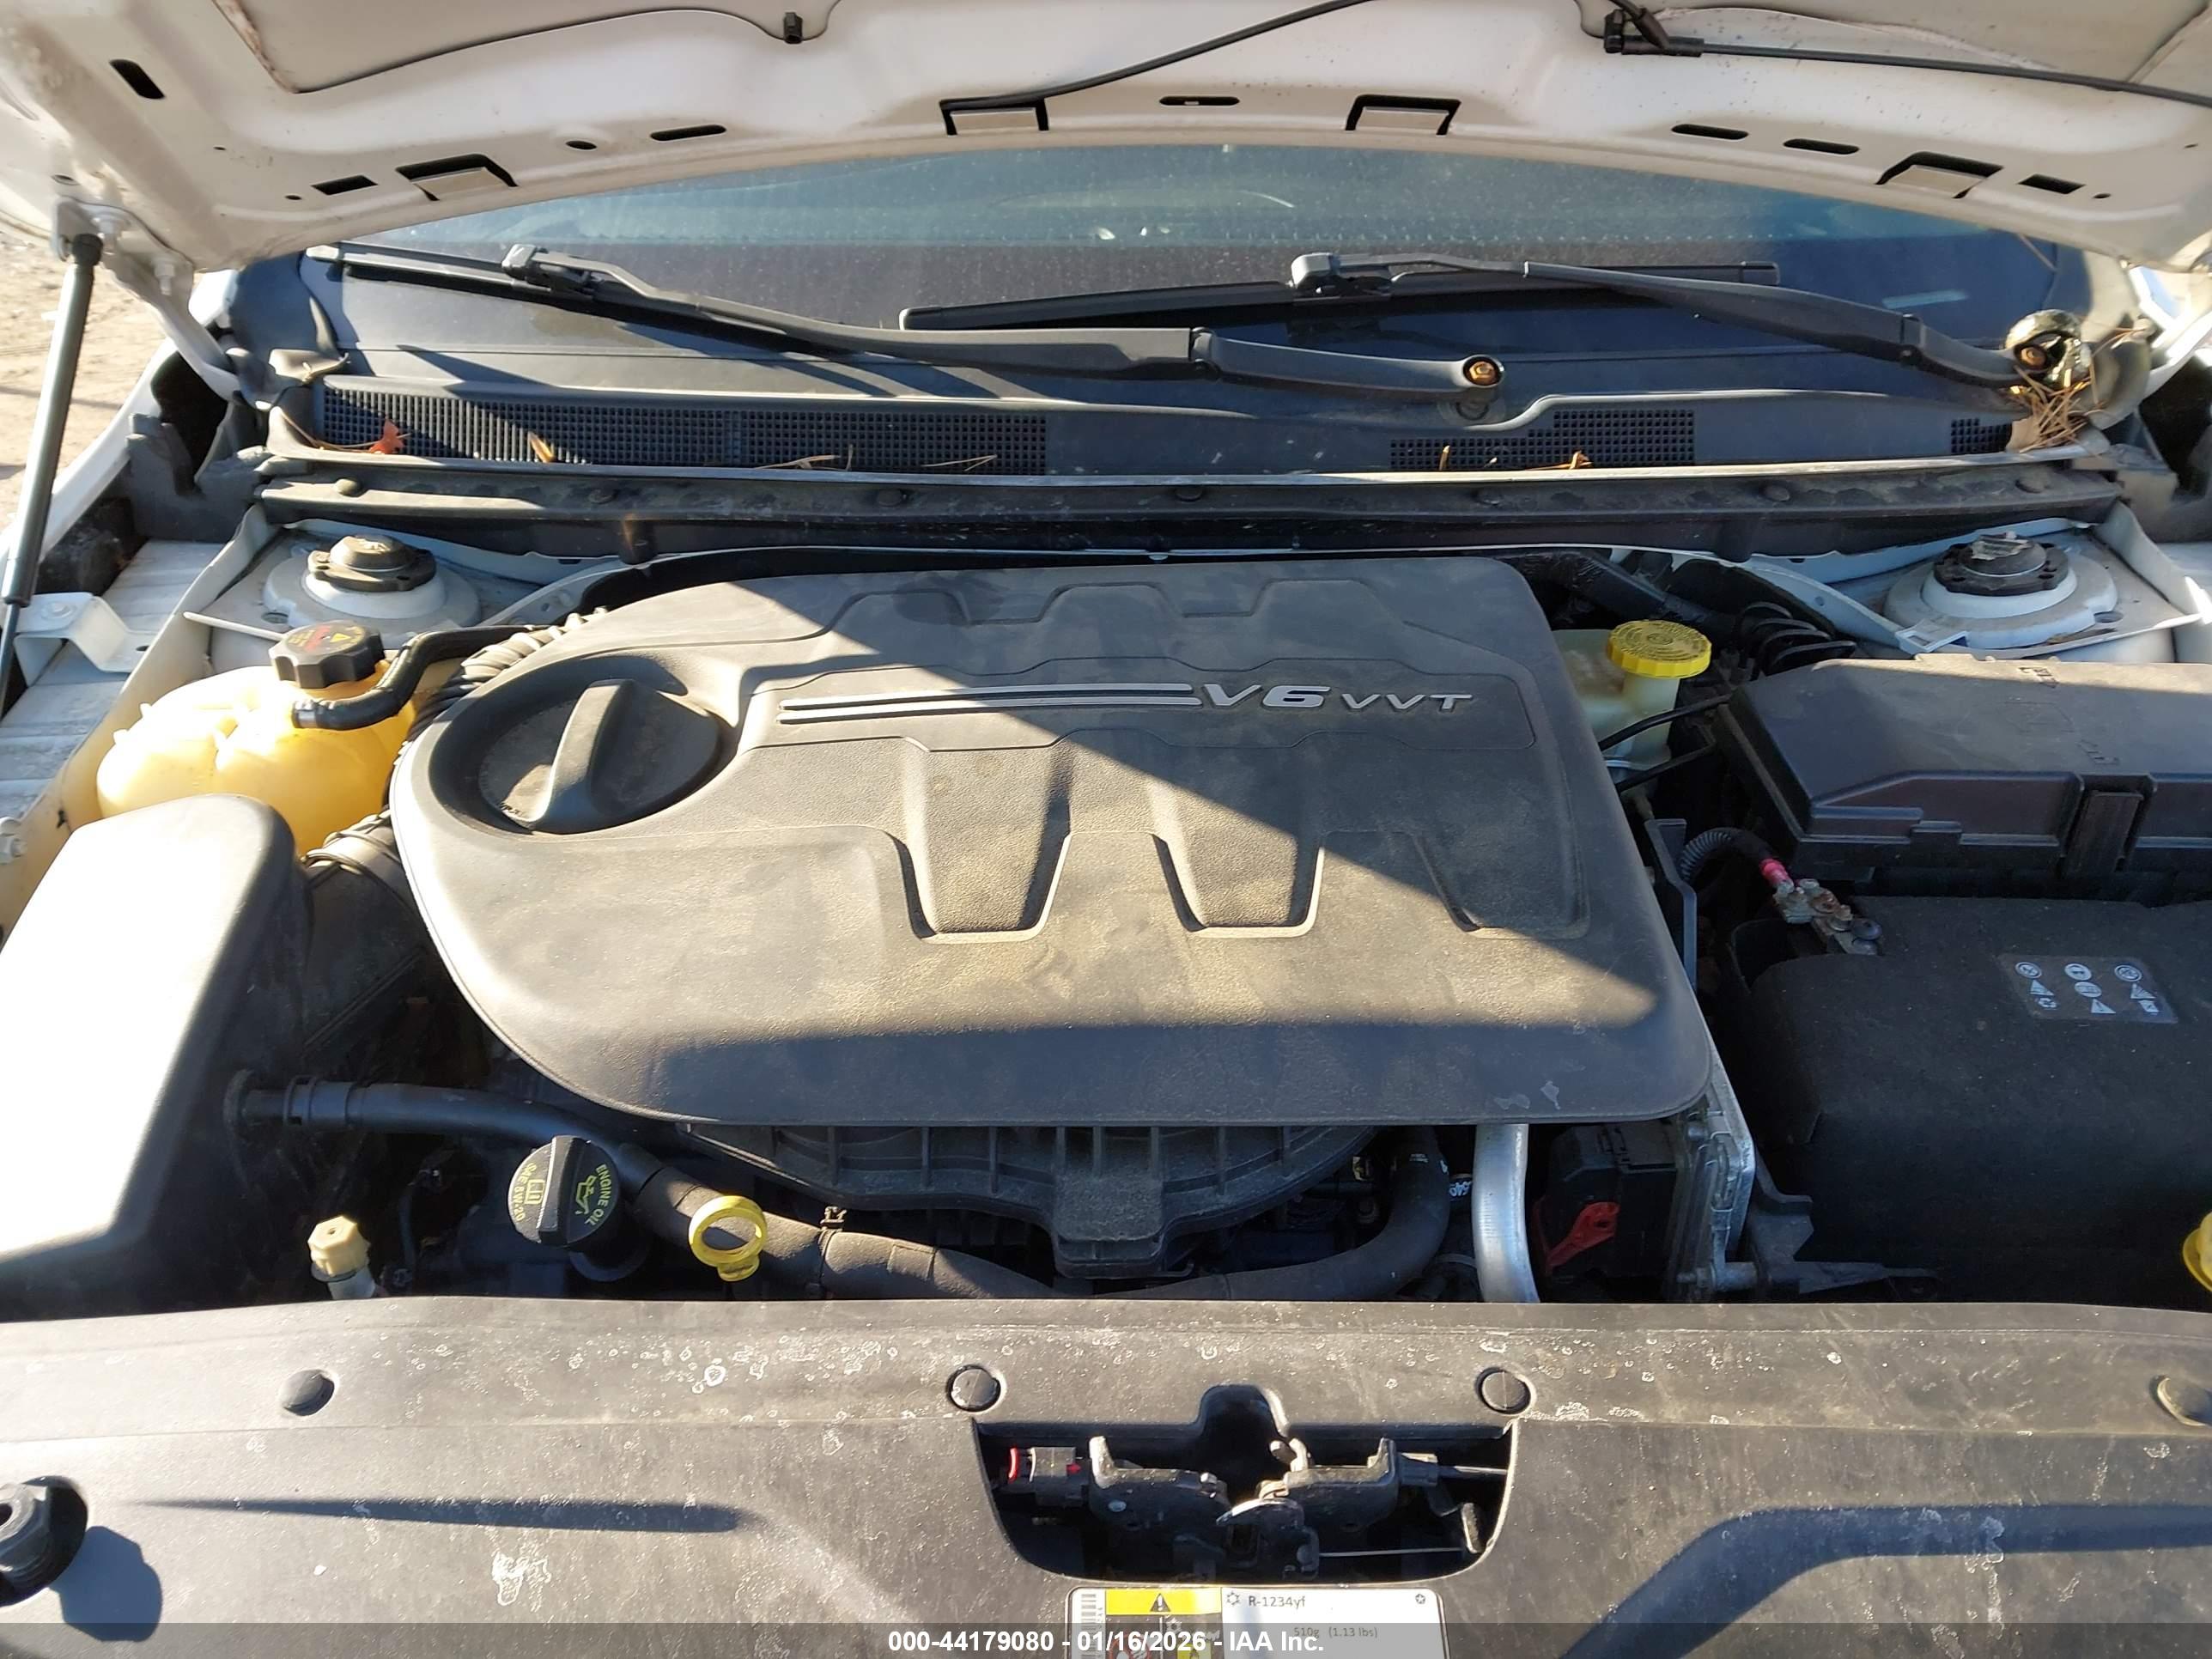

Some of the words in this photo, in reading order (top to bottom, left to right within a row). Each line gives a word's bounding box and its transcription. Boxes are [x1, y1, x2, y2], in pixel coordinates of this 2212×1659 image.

[1204, 684, 1331, 708] V6
[1342, 694, 1473, 709] VVT
[596, 1164, 612, 1207] ENGINE
[584, 1208, 605, 1226] OIL
[1249, 1595, 1306, 1609] R-1234yf
[1294, 1627, 1320, 1638] 510g
[1328, 1626, 1355, 1638] (1.13
[1358, 1626, 1378, 1638] lbs)
